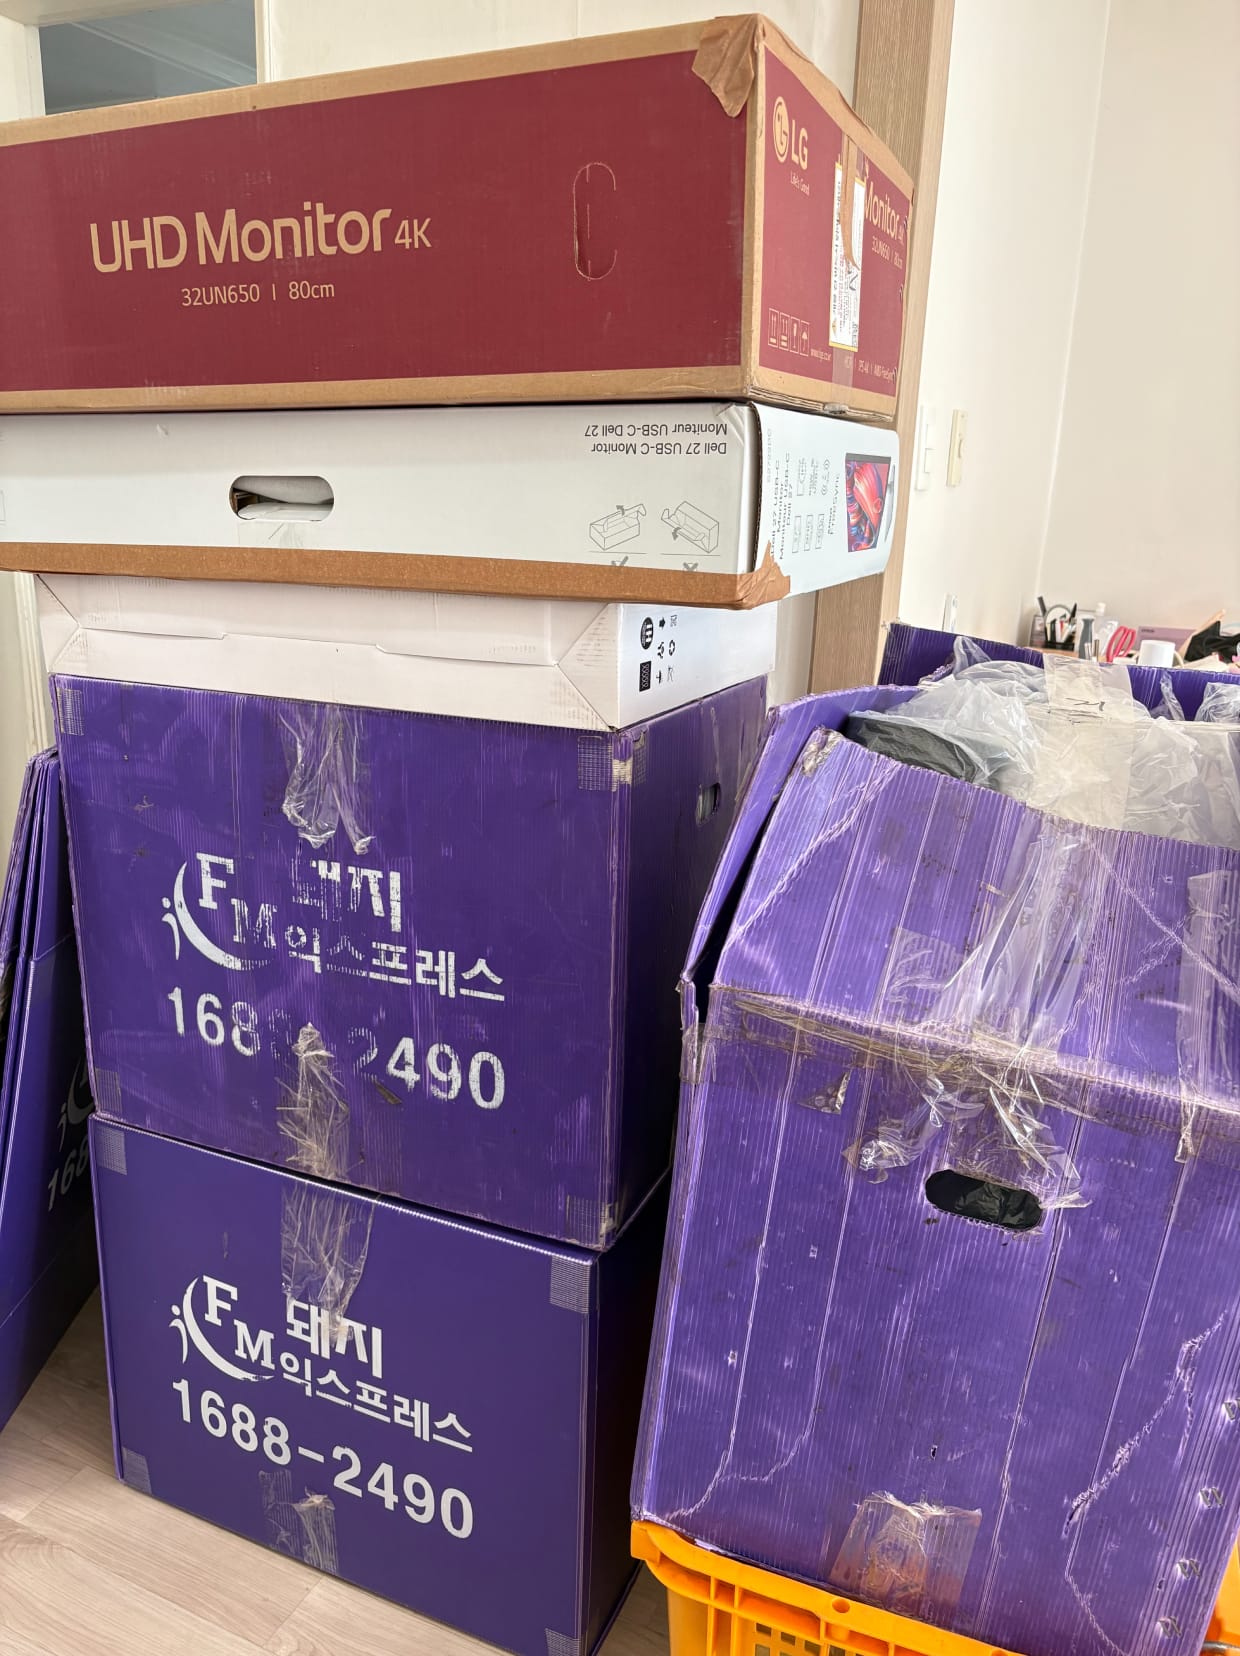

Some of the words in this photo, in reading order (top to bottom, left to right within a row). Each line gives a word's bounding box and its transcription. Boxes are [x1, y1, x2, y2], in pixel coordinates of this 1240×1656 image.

[791, 119, 809, 170] LG
[90, 215, 188, 273] UHD
[196, 201, 392, 265] Monitor
[394, 217, 431, 249] 4K
[181, 283, 261, 307] 32UN650
[288, 281, 335, 302] 80cm
[584, 425, 599, 437] 27
[602, 425, 623, 437] Dell
[627, 424, 668, 437] USB-C
[672, 424, 728, 436] Moniteur
[591, 442, 637, 456] Monitor
[640, 442, 682, 455] USB-C
[686, 442, 701, 455] 27
[704, 442, 728, 455] Dell
[286, 1299, 383, 1380] 돼지
[279, 1351, 473, 1453] 익스프레스
[172, 1377, 474, 1539] 1688-2490
